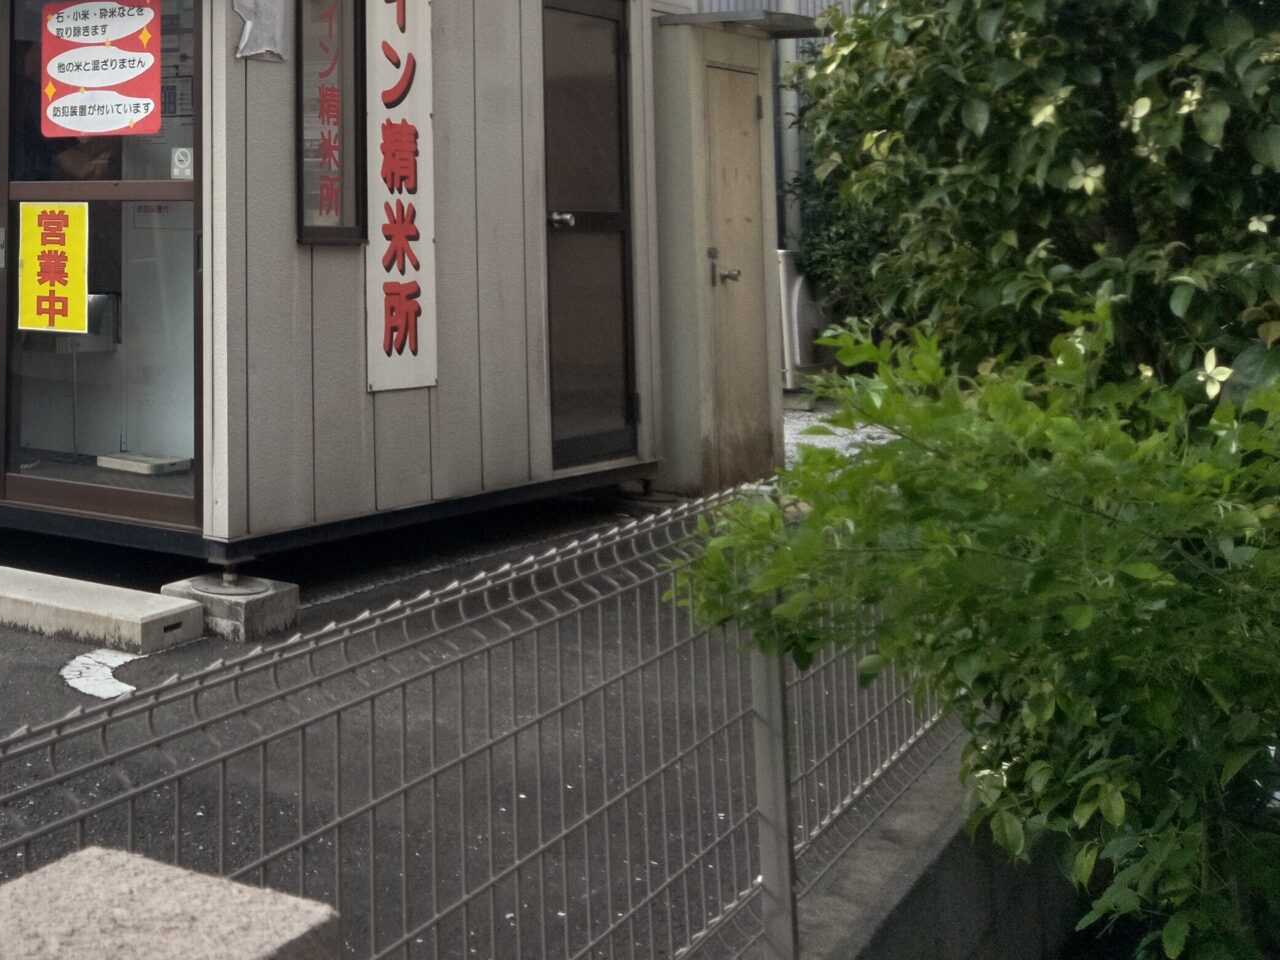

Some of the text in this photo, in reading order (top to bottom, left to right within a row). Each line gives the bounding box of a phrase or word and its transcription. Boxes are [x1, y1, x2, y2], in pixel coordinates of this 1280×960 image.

[55, 7, 145, 24] 石・小米・砕米などを
[55, 24, 108, 38] 取り除きます
[57, 58, 146, 74] 他の米と混ざりません
[52, 102, 151, 118] 防犯装置が付いています
[36, 209, 69, 327] 営業中
